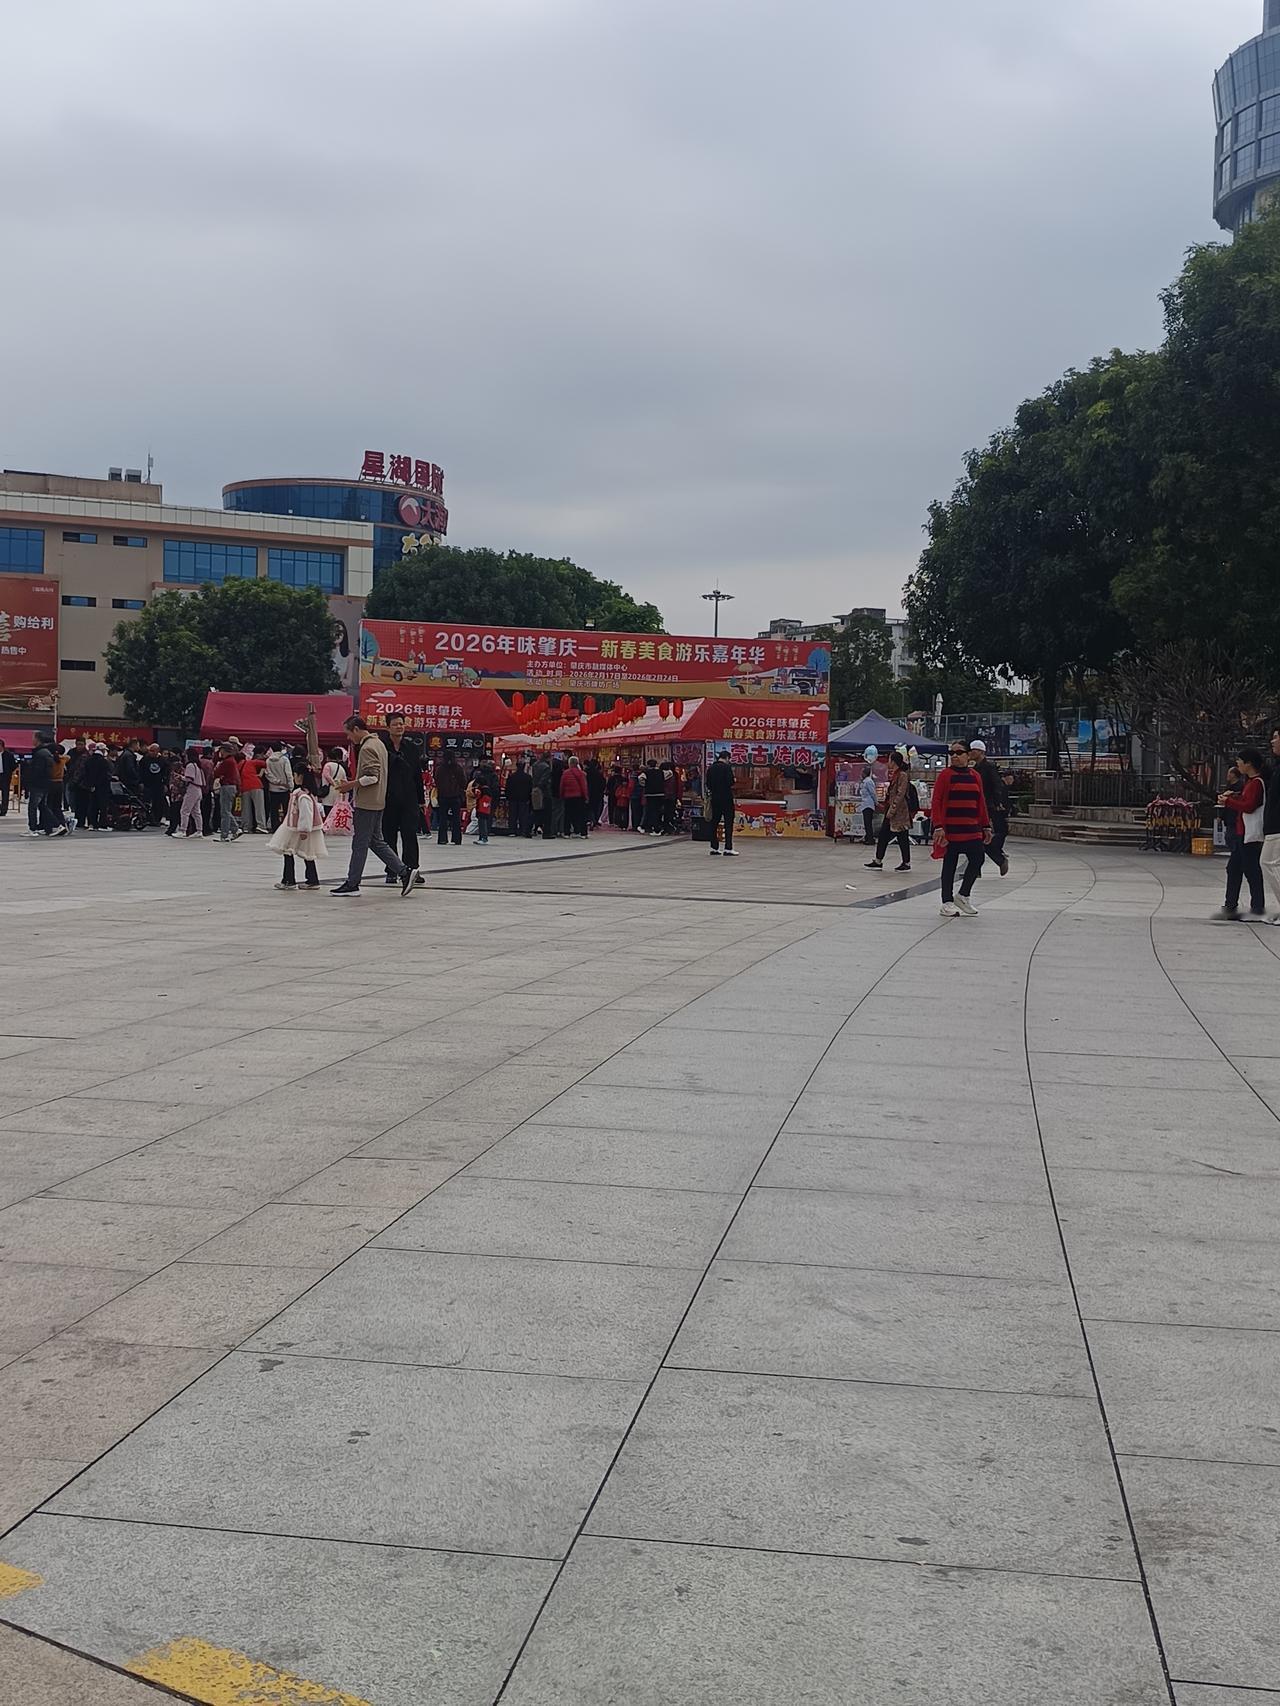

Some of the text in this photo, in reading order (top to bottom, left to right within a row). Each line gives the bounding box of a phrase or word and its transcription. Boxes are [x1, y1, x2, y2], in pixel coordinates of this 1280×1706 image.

[13, 615, 54, 630] 购给利
[375, 703, 463, 717] 2026年味肇庆
[731, 716, 811, 729] 2026年味肇庆
[723, 728, 818, 741] 新春美食游乐嘉年华
[730, 742, 813, 767] 蒙古烤肉
